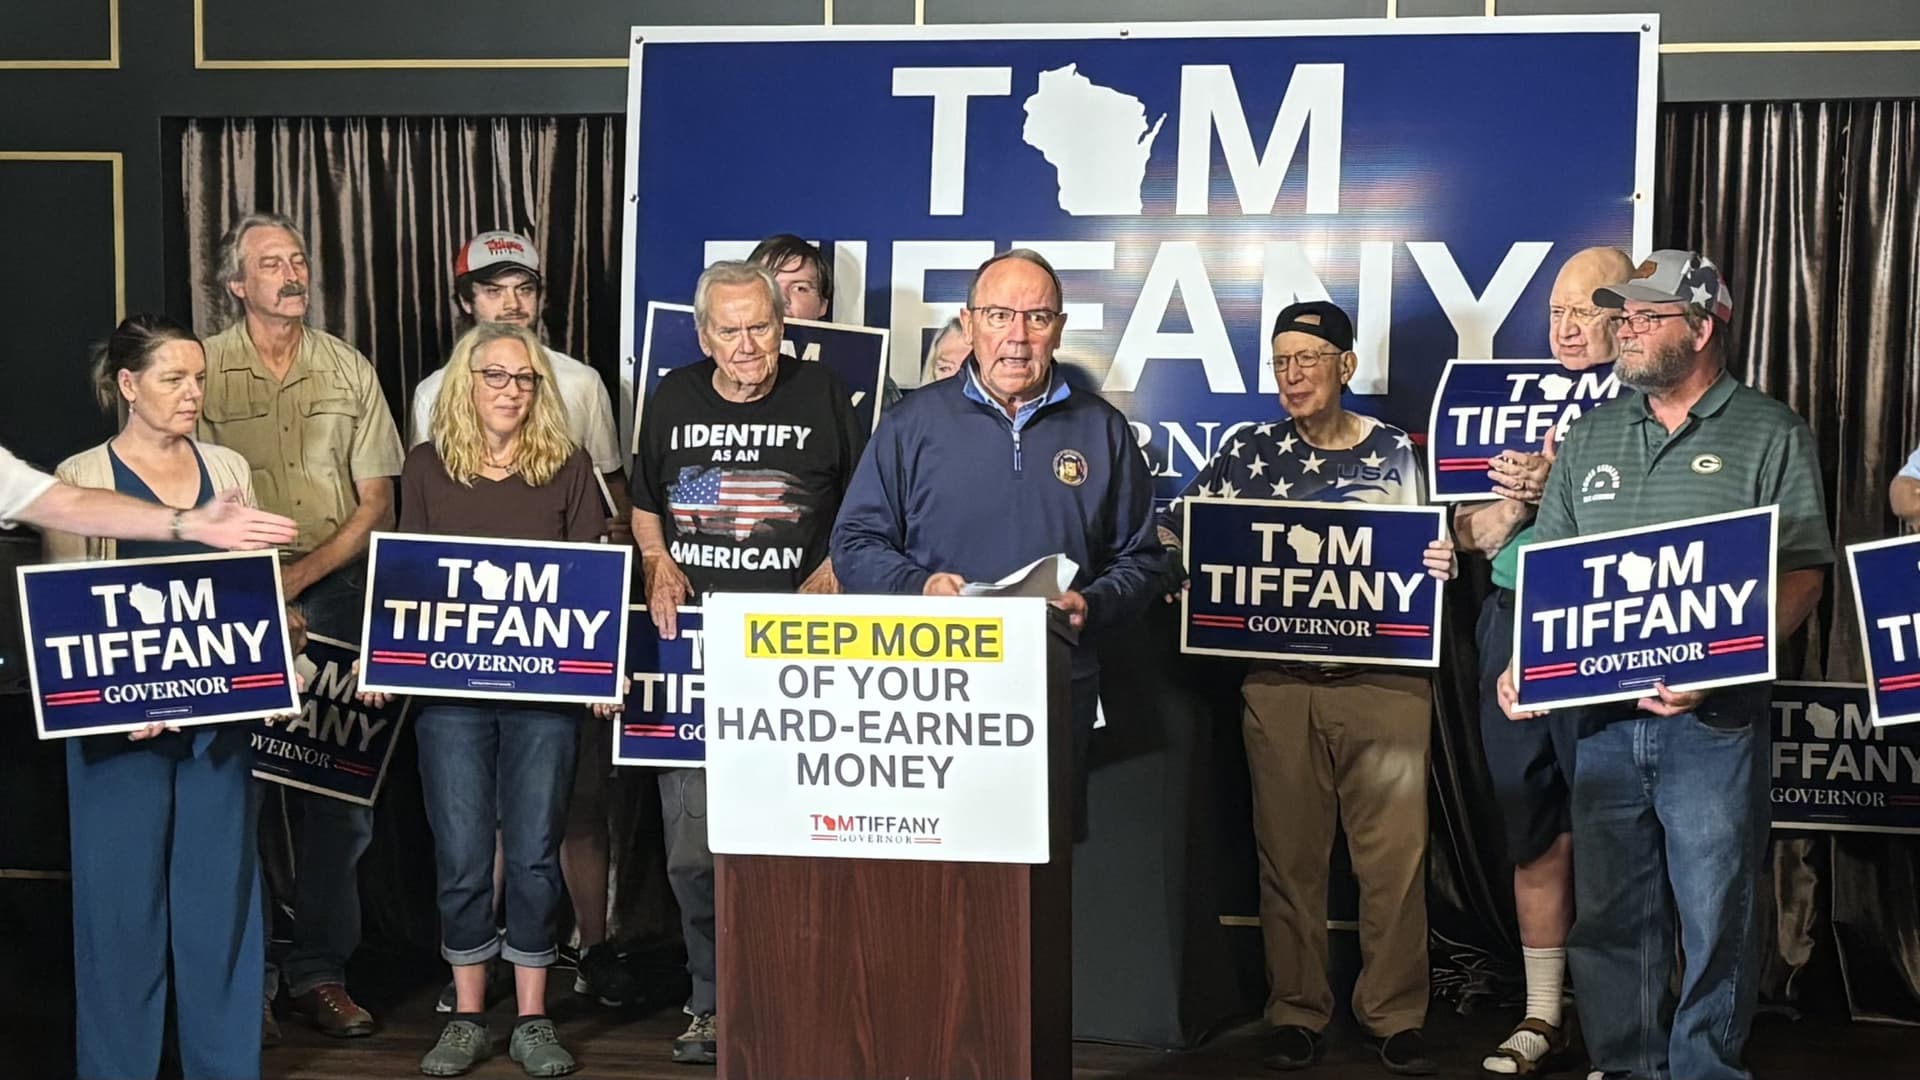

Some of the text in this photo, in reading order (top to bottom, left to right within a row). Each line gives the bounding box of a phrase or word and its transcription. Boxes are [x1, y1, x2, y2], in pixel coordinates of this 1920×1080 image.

[703, 240, 1554, 396] IFANY
[670, 424, 812, 450] I IDENTIFY
[1448, 403, 1583, 446] TIFFA
[712, 450, 759, 462] AS AN
[1337, 464, 1402, 487] USA
[670, 541, 804, 570] AMERICAN
[1200, 564, 1424, 613] TIFFANY
[384, 599, 610, 650] TIFFANY
[1248, 616, 1372, 637] GOVERNOR
[1532, 579, 1758, 653] TIFFANY
[45, 620, 270, 679] TIFFANY
[750, 620, 999, 657] KEEP MORE
[430, 652, 556, 675] GOVERNOR
[1580, 642, 1705, 676] GOVERNOR
[104, 676, 229, 704] GOVERNOR
[778, 664, 970, 702] OF YOUR
[717, 707, 1035, 747] HARD-EARNED
[251, 732, 331, 769] VERNOR
[1771, 742, 1920, 784] FFANY
[797, 752, 954, 789] MONEY
[1769, 786, 1886, 808] GOVERNOR
[839, 833, 912, 845] GOVERNOR
